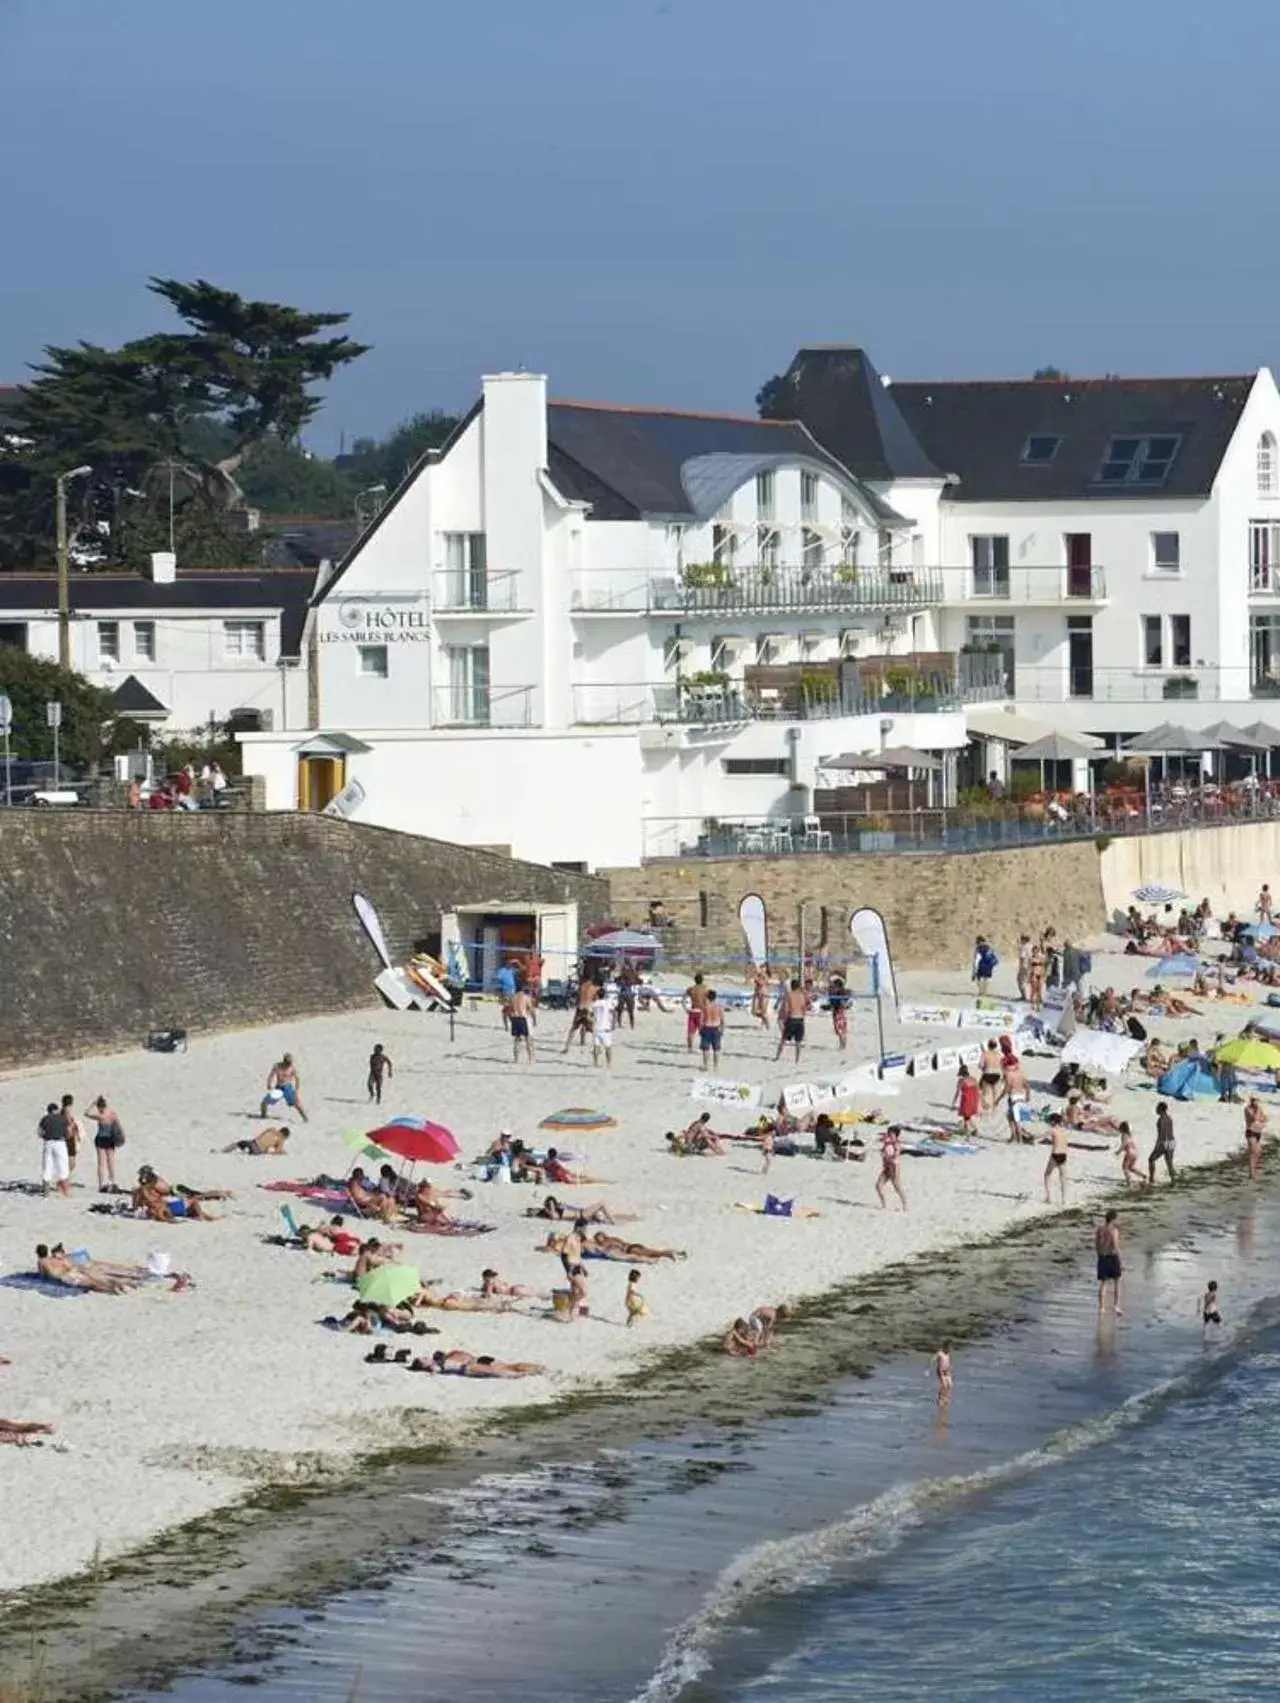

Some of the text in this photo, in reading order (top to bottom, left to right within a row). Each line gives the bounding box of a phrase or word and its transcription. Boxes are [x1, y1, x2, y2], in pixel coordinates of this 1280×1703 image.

[366, 607, 430, 627] HÔTEL
[320, 631, 340, 643] LES
[384, 630, 432, 642] BLANCS
